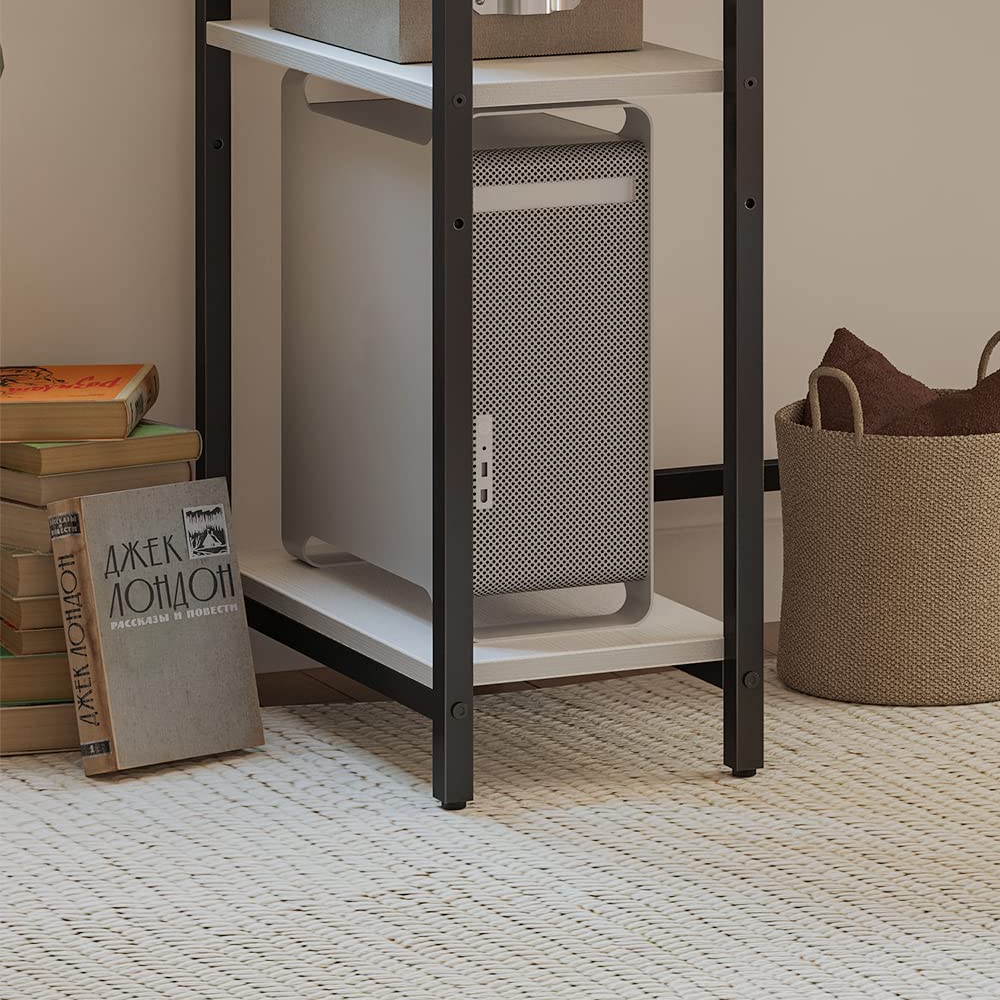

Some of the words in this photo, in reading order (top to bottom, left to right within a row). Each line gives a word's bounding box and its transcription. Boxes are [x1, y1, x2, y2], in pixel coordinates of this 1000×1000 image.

[104, 535, 183, 579] ДЖЕК
[58, 553, 88, 657] ЛОНДОН
[109, 564, 235, 618] ЛОНДОН
[110, 613, 170, 631] РАССКАЗЫ
[174, 611, 182, 621] И
[186, 603, 238, 619] ПОВЕСТИ
[73, 663, 100, 727] ДЖЕК
